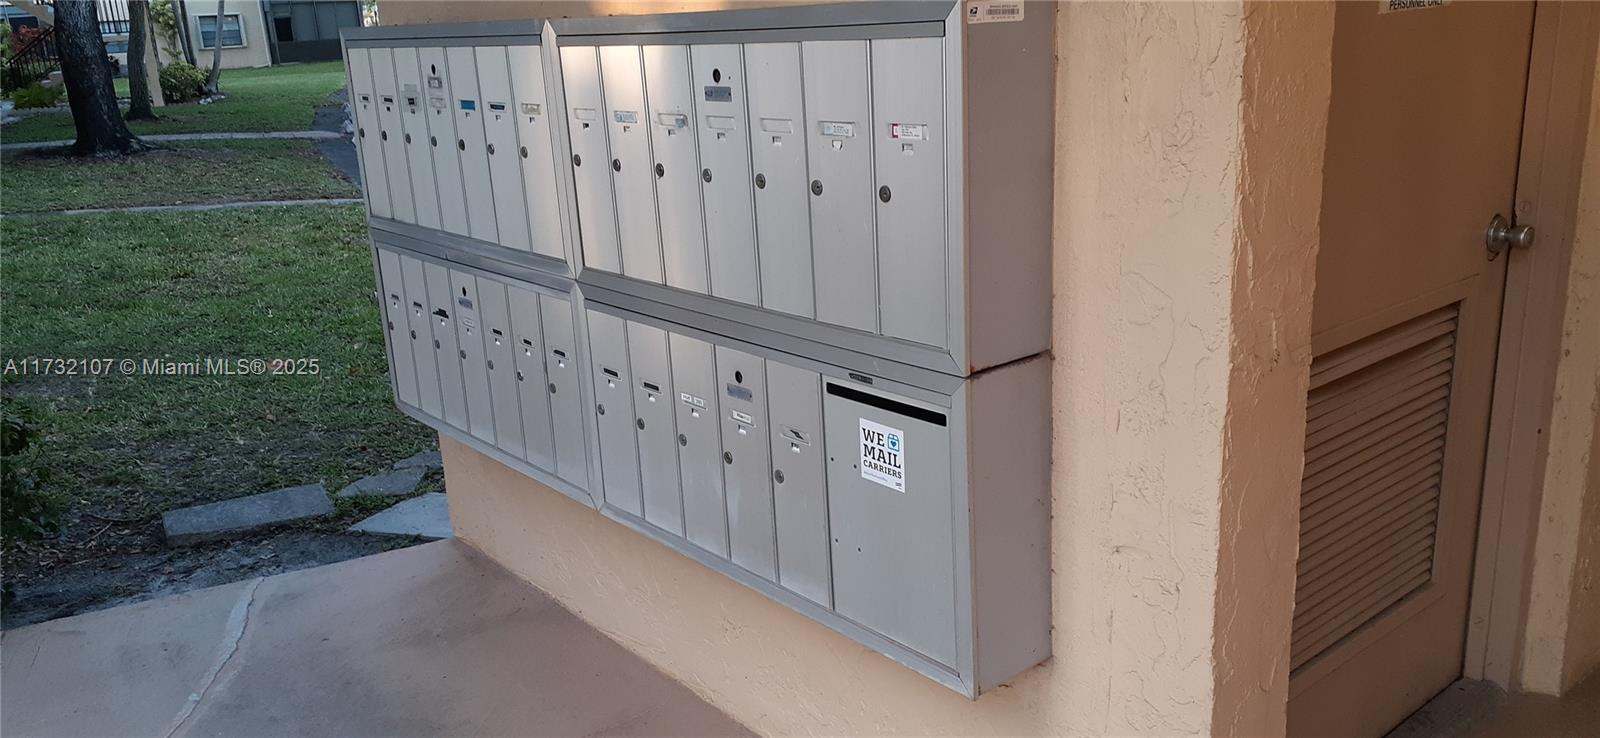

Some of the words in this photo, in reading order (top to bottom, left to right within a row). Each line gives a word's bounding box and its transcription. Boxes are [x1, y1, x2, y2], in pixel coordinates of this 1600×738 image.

[1389, 0, 1425, 10] PERSONNEL
[862, 427, 885, 447] WE
[863, 443, 901, 469] MAIL
[863, 459, 902, 480] CARRIERS
